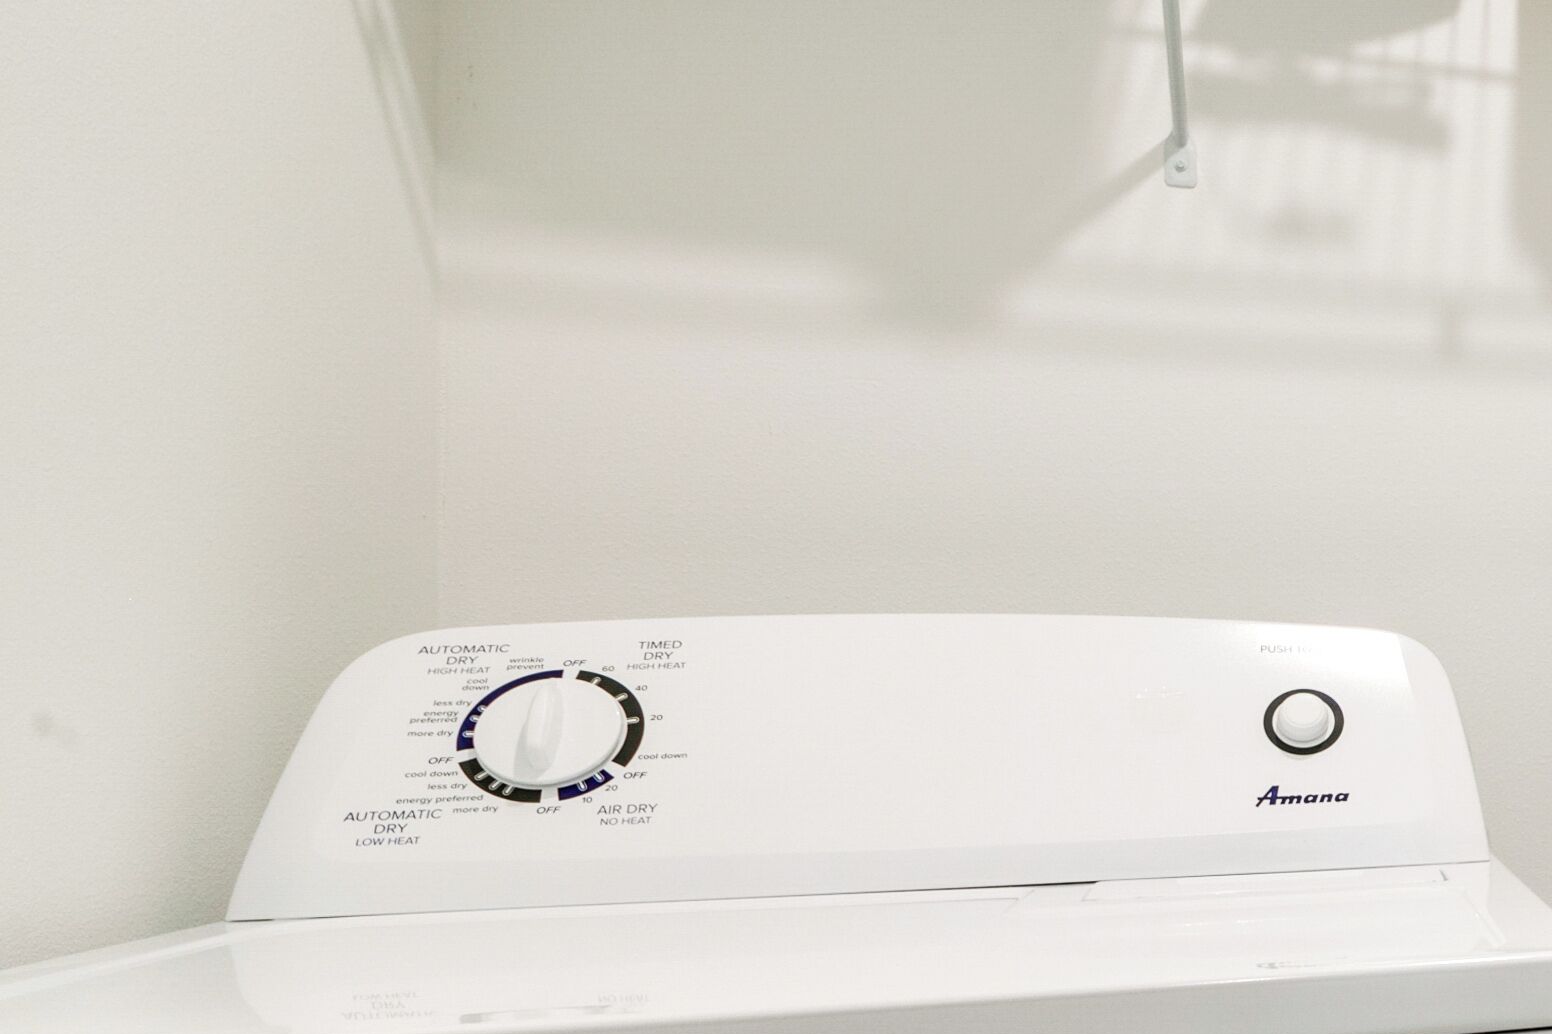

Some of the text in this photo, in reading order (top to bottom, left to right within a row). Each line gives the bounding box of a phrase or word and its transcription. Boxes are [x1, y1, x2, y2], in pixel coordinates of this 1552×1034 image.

[417, 643, 511, 655] AUTOMATIC
[638, 640, 683, 650] TIMED
[446, 655, 479, 666] DRY
[643, 651, 675, 661] DRY
[506, 663, 544, 671] prevent
[563, 659, 588, 667] OFF
[626, 661, 687, 670] HIGH HEAT
[427, 666, 491, 675] HIGH HEAT
[455, 699, 473, 707] dry
[423, 710, 459, 718] energy
[437, 729, 454, 737] dry
[661, 751, 688, 760] down
[428, 756, 455, 765] OFF
[404, 769, 459, 778] cool down
[623, 771, 648, 780] OFF
[450, 782, 468, 790] dry
[604, 784, 618, 792] 20
[395, 794, 484, 805] energy preferred
[1256, 785, 1350, 807] Amana
[452, 805, 499, 814] more dry
[536, 806, 562, 815] OFF
[596, 803, 659, 816] AIR DRY
[343, 808, 443, 822] AUTOMATIC
[599, 816, 652, 826] NO HEAT
[373, 823, 408, 835] DRY
[355, 836, 421, 847] LOW HEAT
